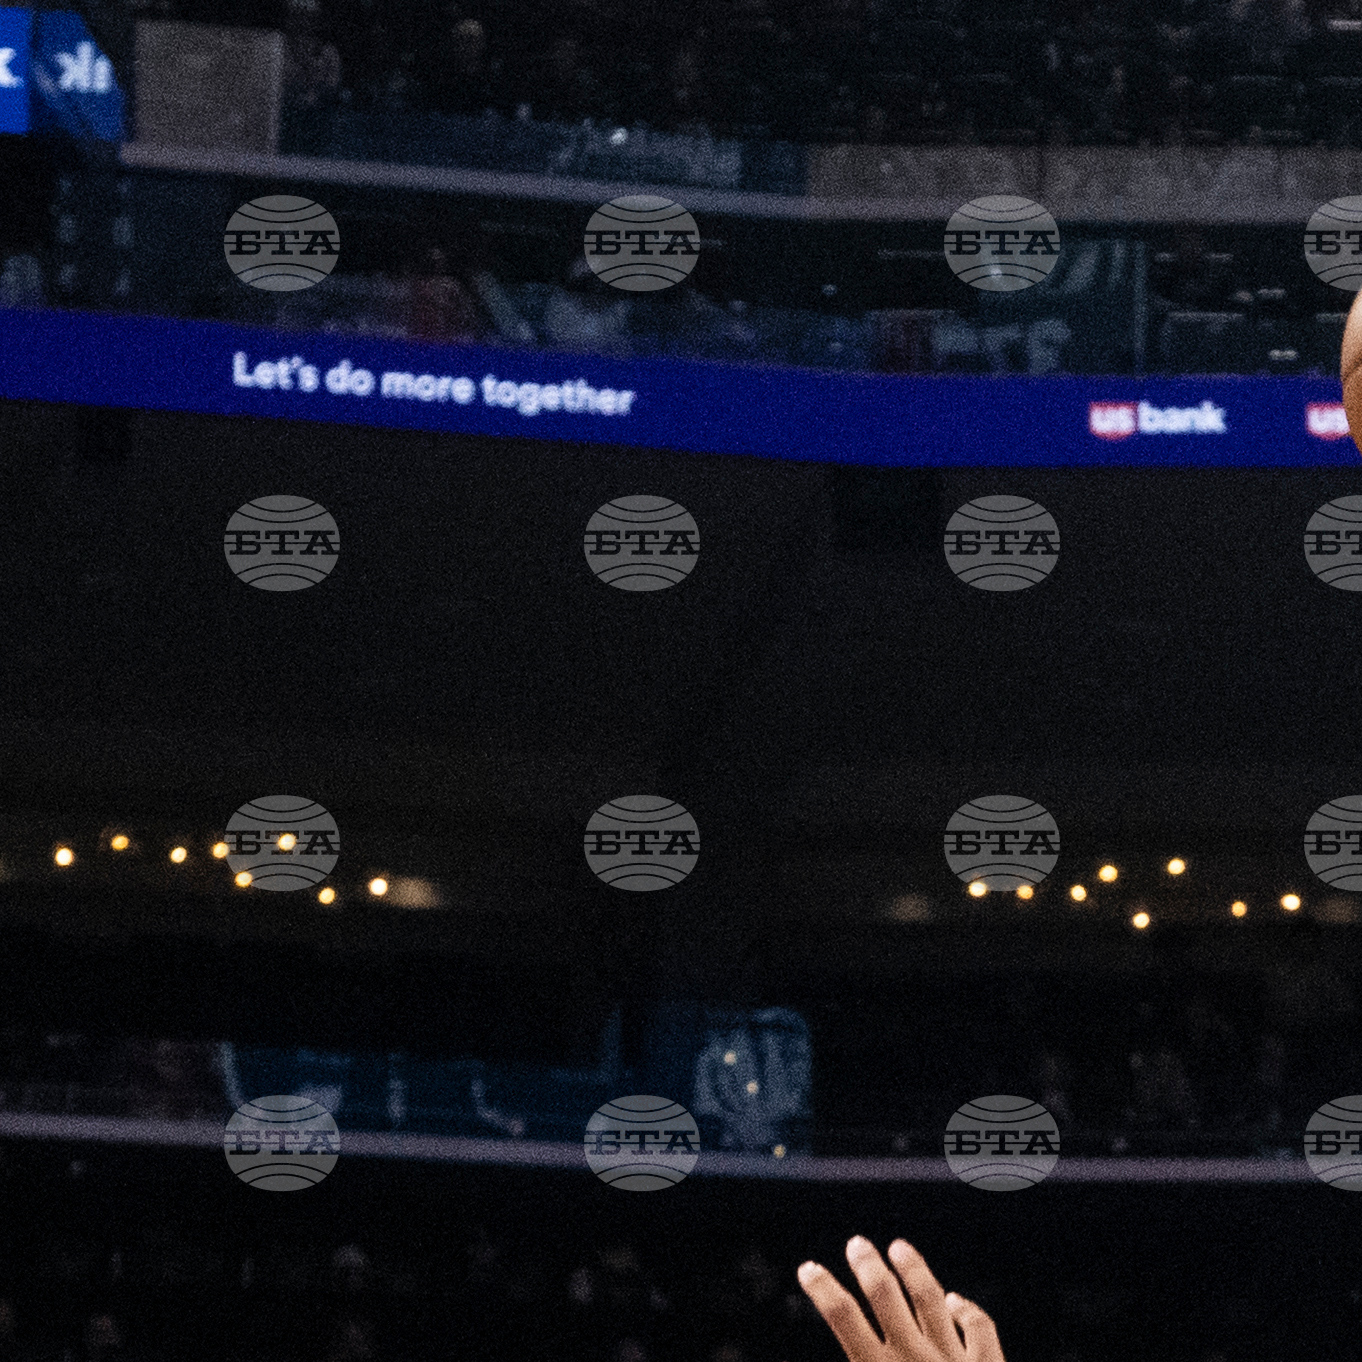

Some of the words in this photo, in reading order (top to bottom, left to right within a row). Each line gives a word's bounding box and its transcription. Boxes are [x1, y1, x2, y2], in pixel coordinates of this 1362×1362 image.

[232, 351, 319, 393] Let's
[325, 359, 376, 396] do
[380, 370, 476, 404] more
[481, 373, 637, 416] together
